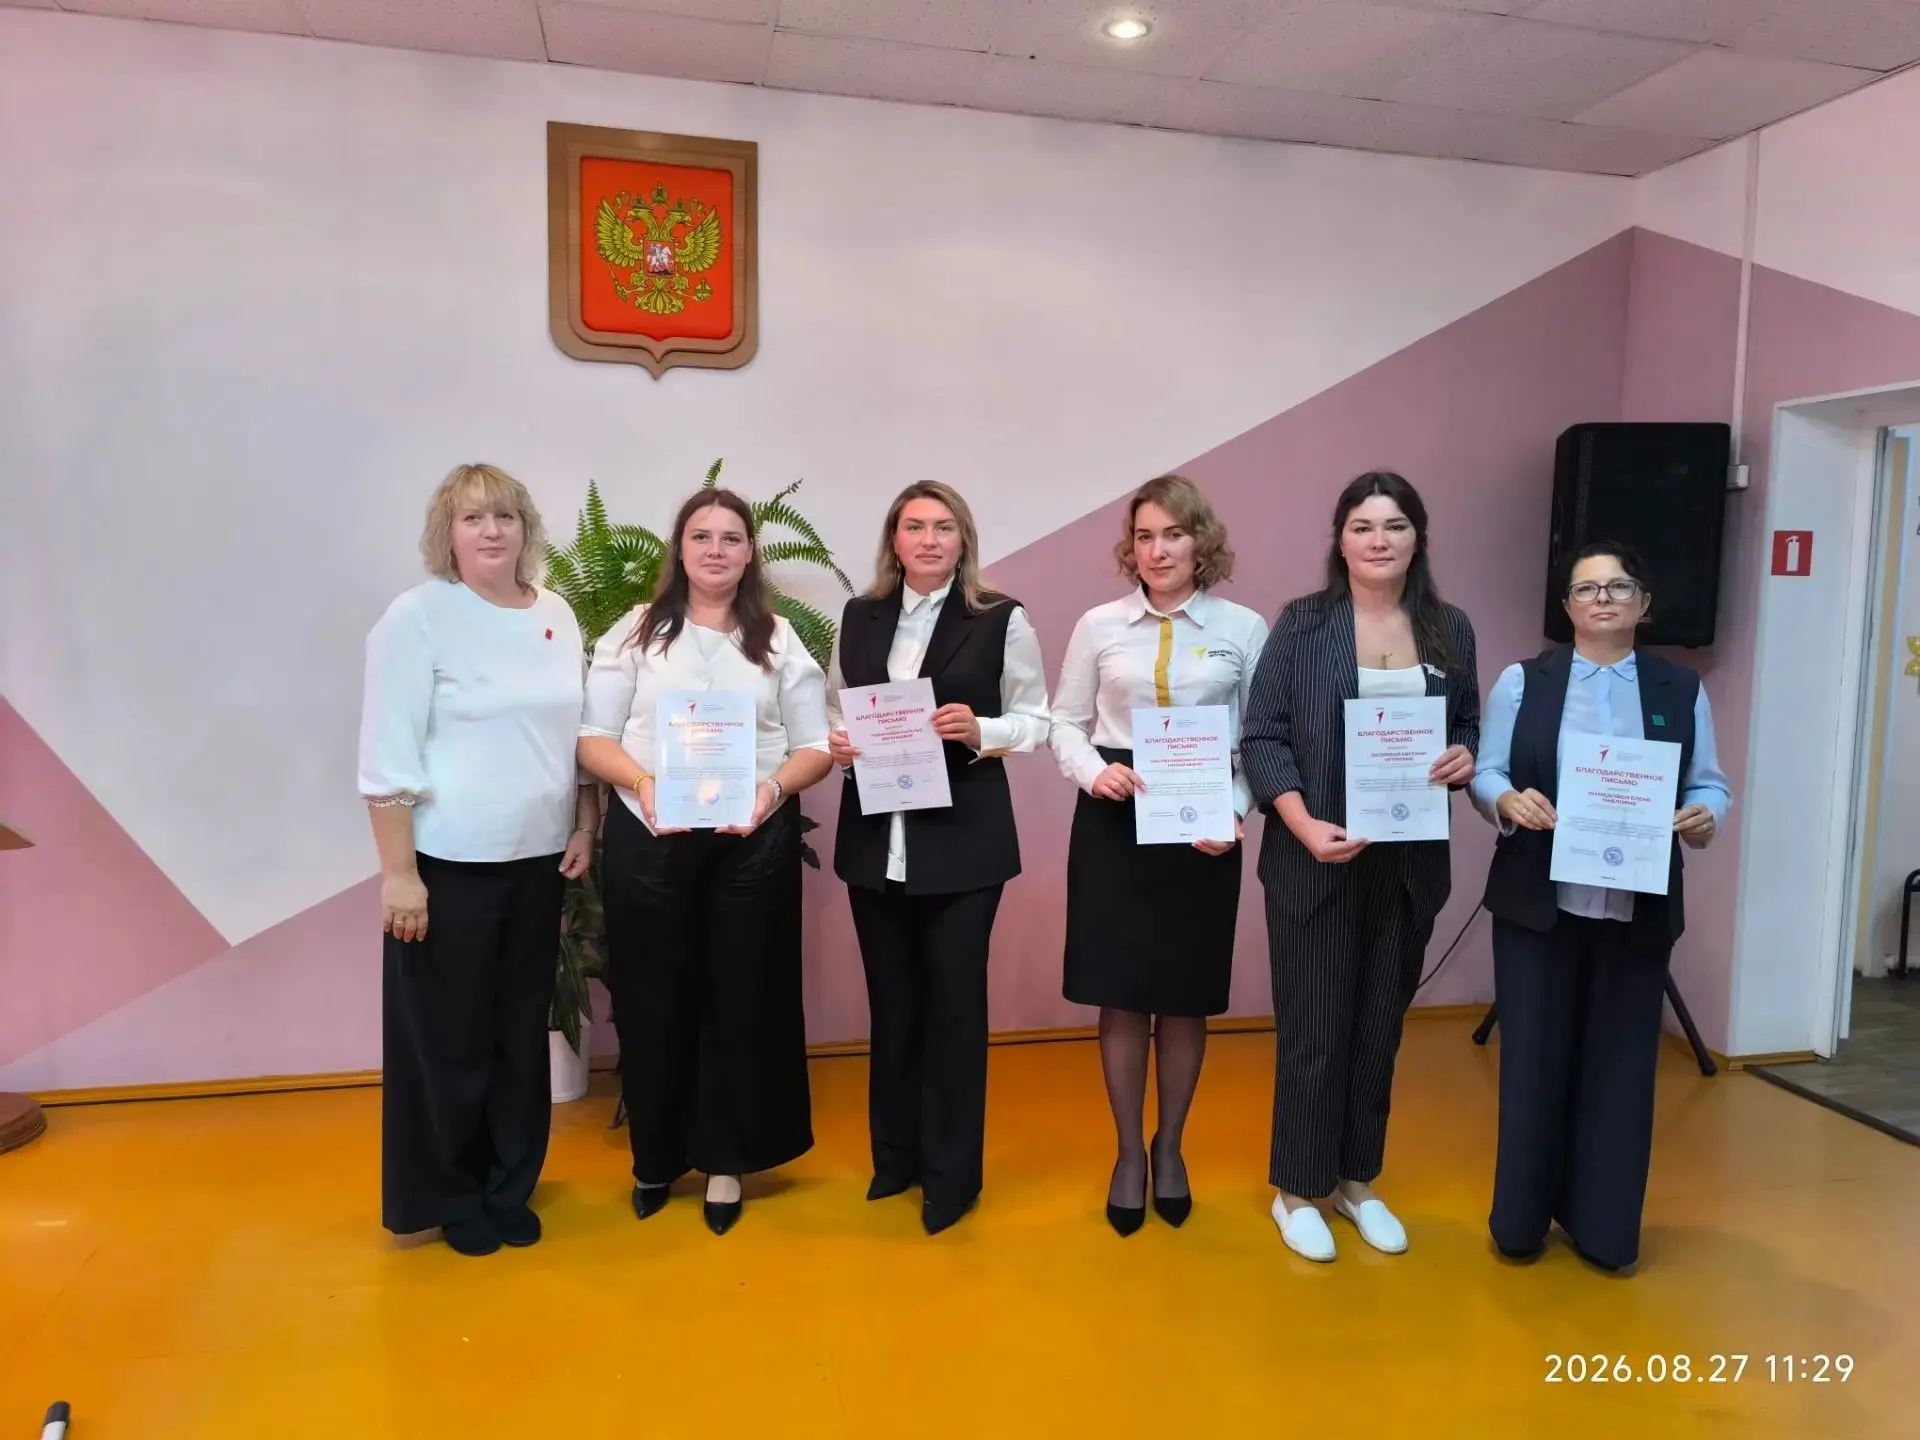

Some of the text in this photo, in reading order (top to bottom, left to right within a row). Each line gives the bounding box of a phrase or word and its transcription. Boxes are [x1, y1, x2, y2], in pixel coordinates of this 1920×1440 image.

[855, 708, 925, 721] БЛАГОДАРСТВЕННОЕ
[878, 716, 908, 725] ПИСЬМО
[1357, 729, 1434, 737] БЛАГОДАРСТВЕННОЕ
[1144, 736, 1219, 744] БЛАГОДАРСТВЕННОЕ
[1575, 766, 1664, 782] БЛАГОДАРСТВЕННОЕ
[1601, 777, 1638, 786] ПИСЬМО
